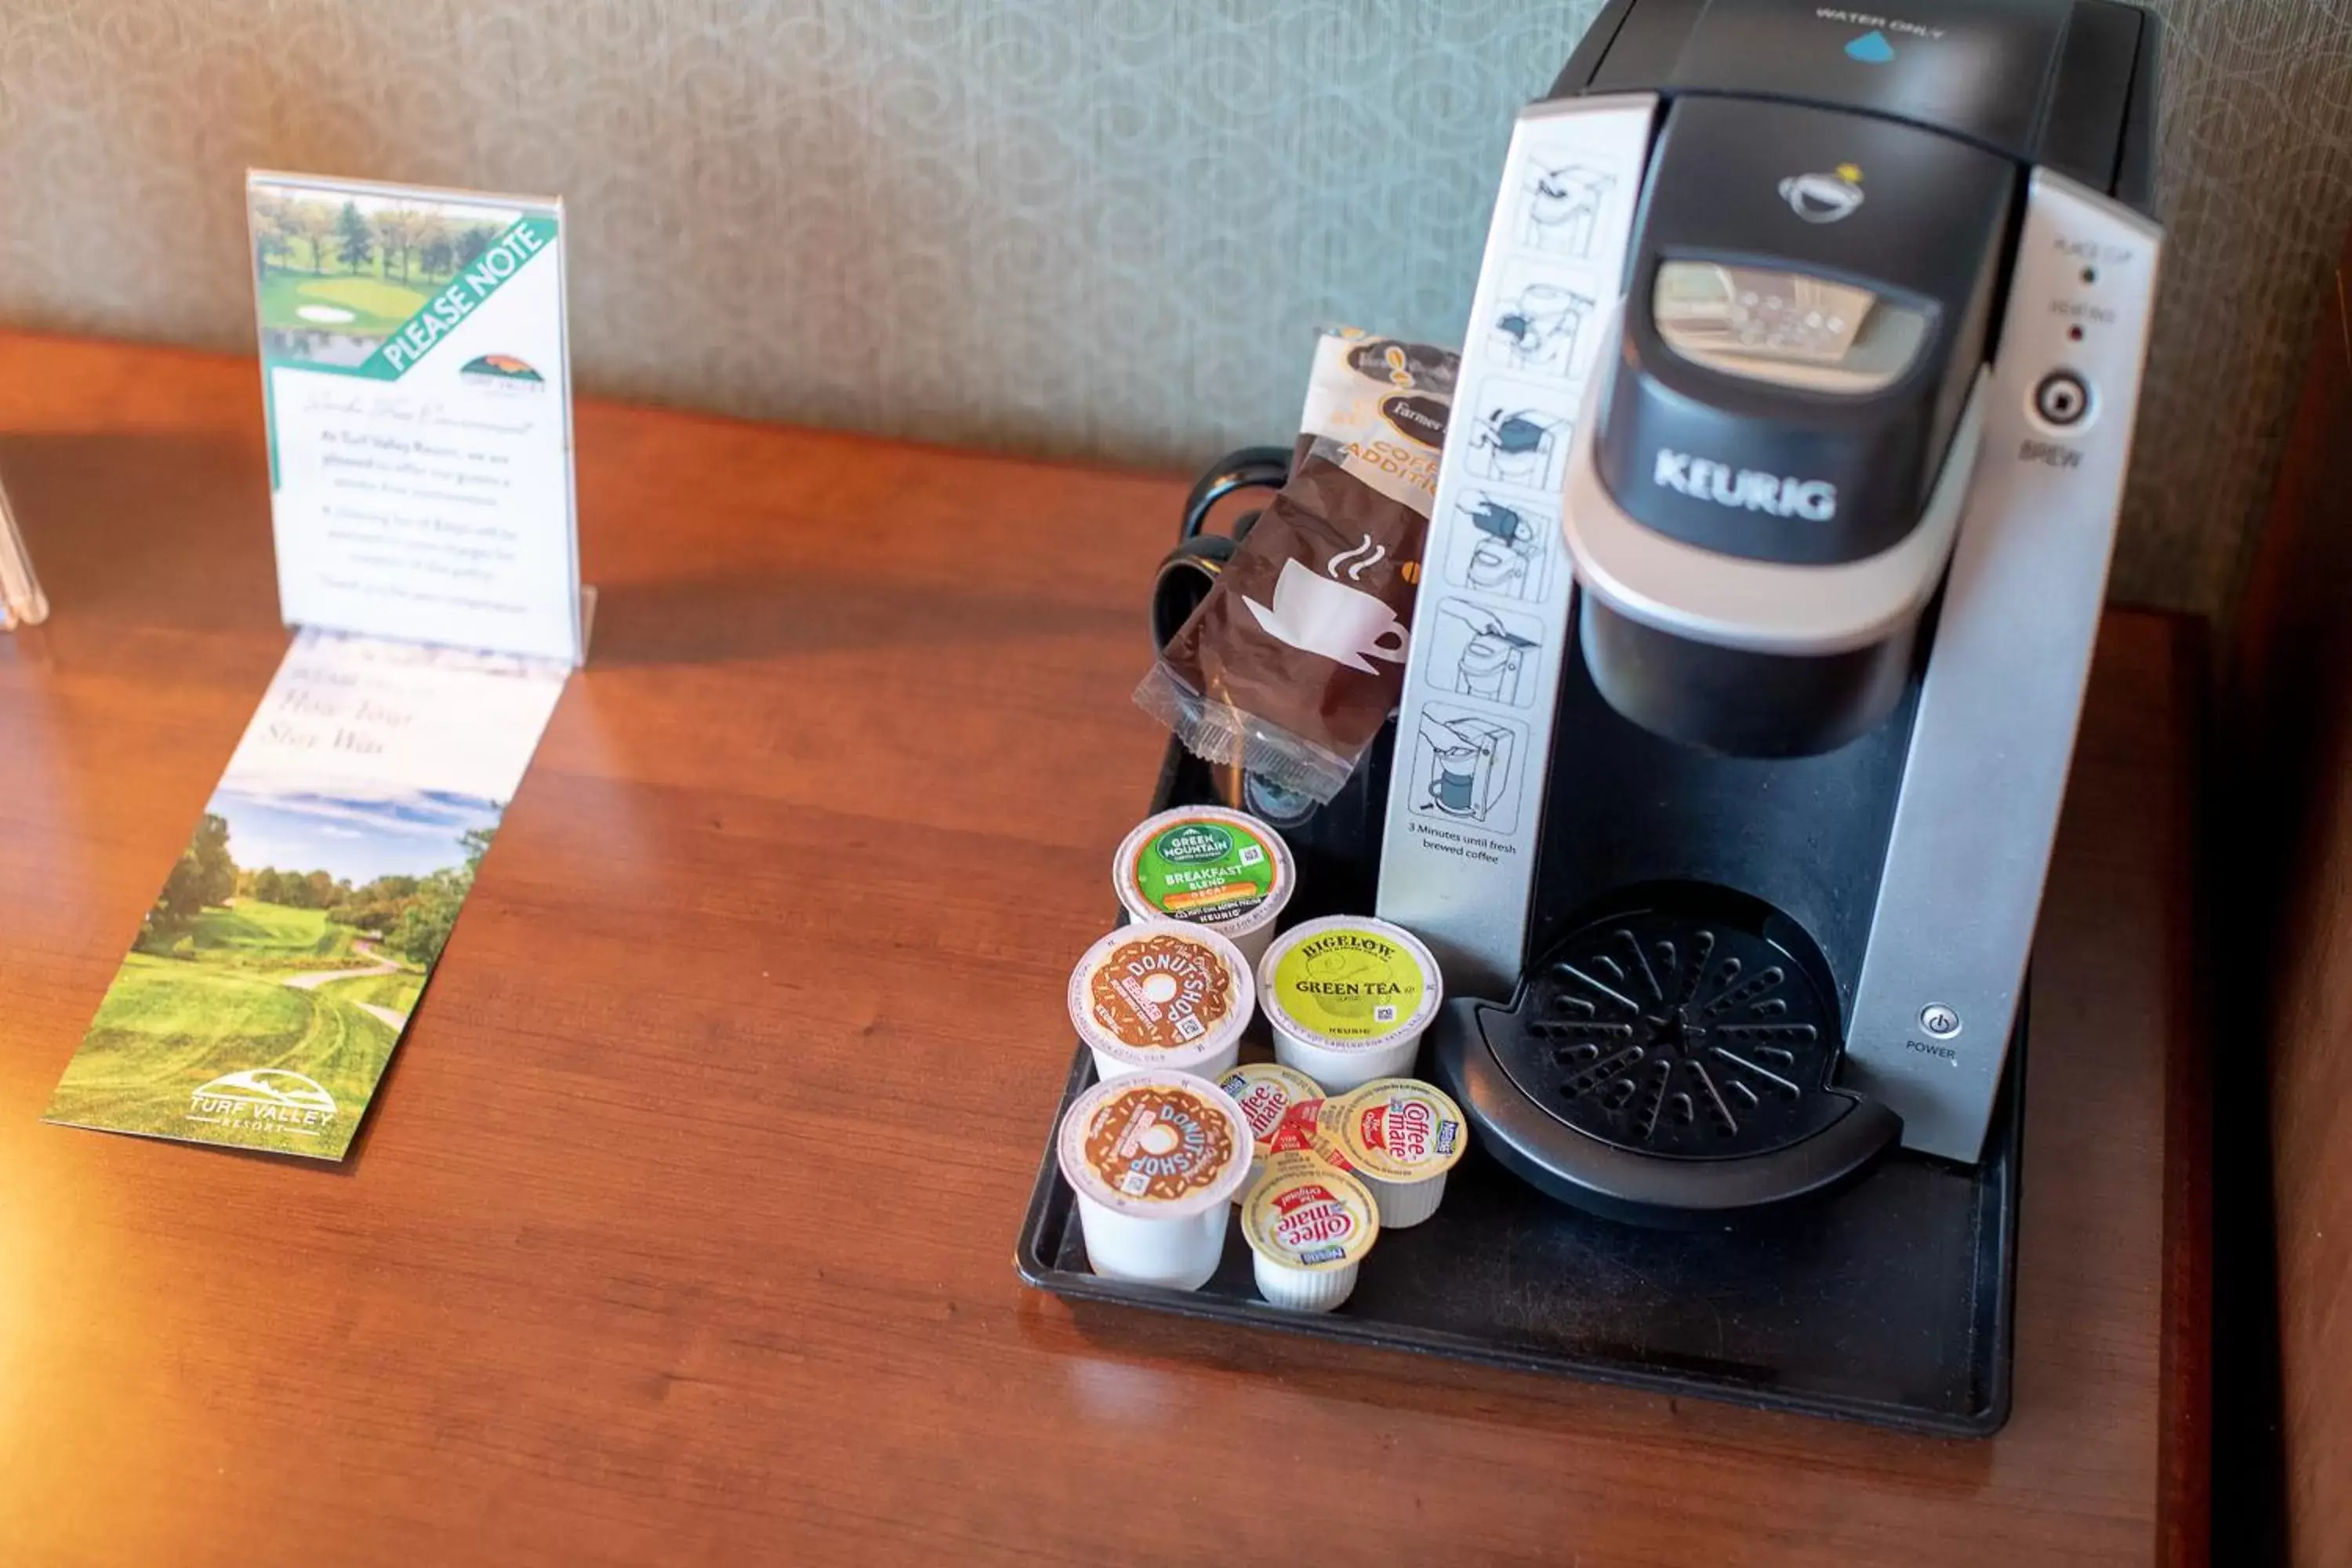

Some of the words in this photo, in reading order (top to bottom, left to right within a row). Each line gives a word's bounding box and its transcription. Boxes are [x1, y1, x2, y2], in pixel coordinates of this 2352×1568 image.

[1817, 7, 1886, 27] WATER
[1889, 20, 1946, 40] ONLY
[383, 285, 474, 372] PLEASE
[465, 222, 543, 299] NOTE
[1392, 401, 1443, 430] Farmer
[2017, 439, 2083, 469] BREW
[1653, 448, 1838, 522] KEURIG
[1163, 840, 1229, 857] MOUNTAIN
[1171, 833, 1215, 847] GREEN
[1408, 822, 1415, 833] 3
[1417, 822, 1461, 843] Minutes
[1463, 836, 1487, 848] until
[1490, 841, 1518, 855] fresh
[1423, 838, 1464, 855] brewed
[1465, 849, 1499, 865] coffee
[1164, 865, 1242, 886] BREAKFAST
[1189, 877, 1225, 891] BLEND
[1199, 909, 1240, 924] KEURIG
[1302, 935, 1396, 959] BIGELOW
[1127, 953, 1197, 977] DONUT
[1167, 979, 1204, 1022] SHOP
[1296, 981, 1359, 995] GREEN
[1363, 982, 1401, 995] TEA
[1906, 1040, 1955, 1059] POWER
[191, 1098, 246, 1115] TURF
[252, 1105, 333, 1127] VALLEY
[222, 1118, 285, 1133] RESORT
[1253, 1093, 1288, 1132] mate
[1160, 1104, 1205, 1156] DONUT
[1389, 1113, 1406, 1157] mate
[1131, 1153, 1190, 1176] SHOP
[1279, 1204, 1330, 1232] mate
